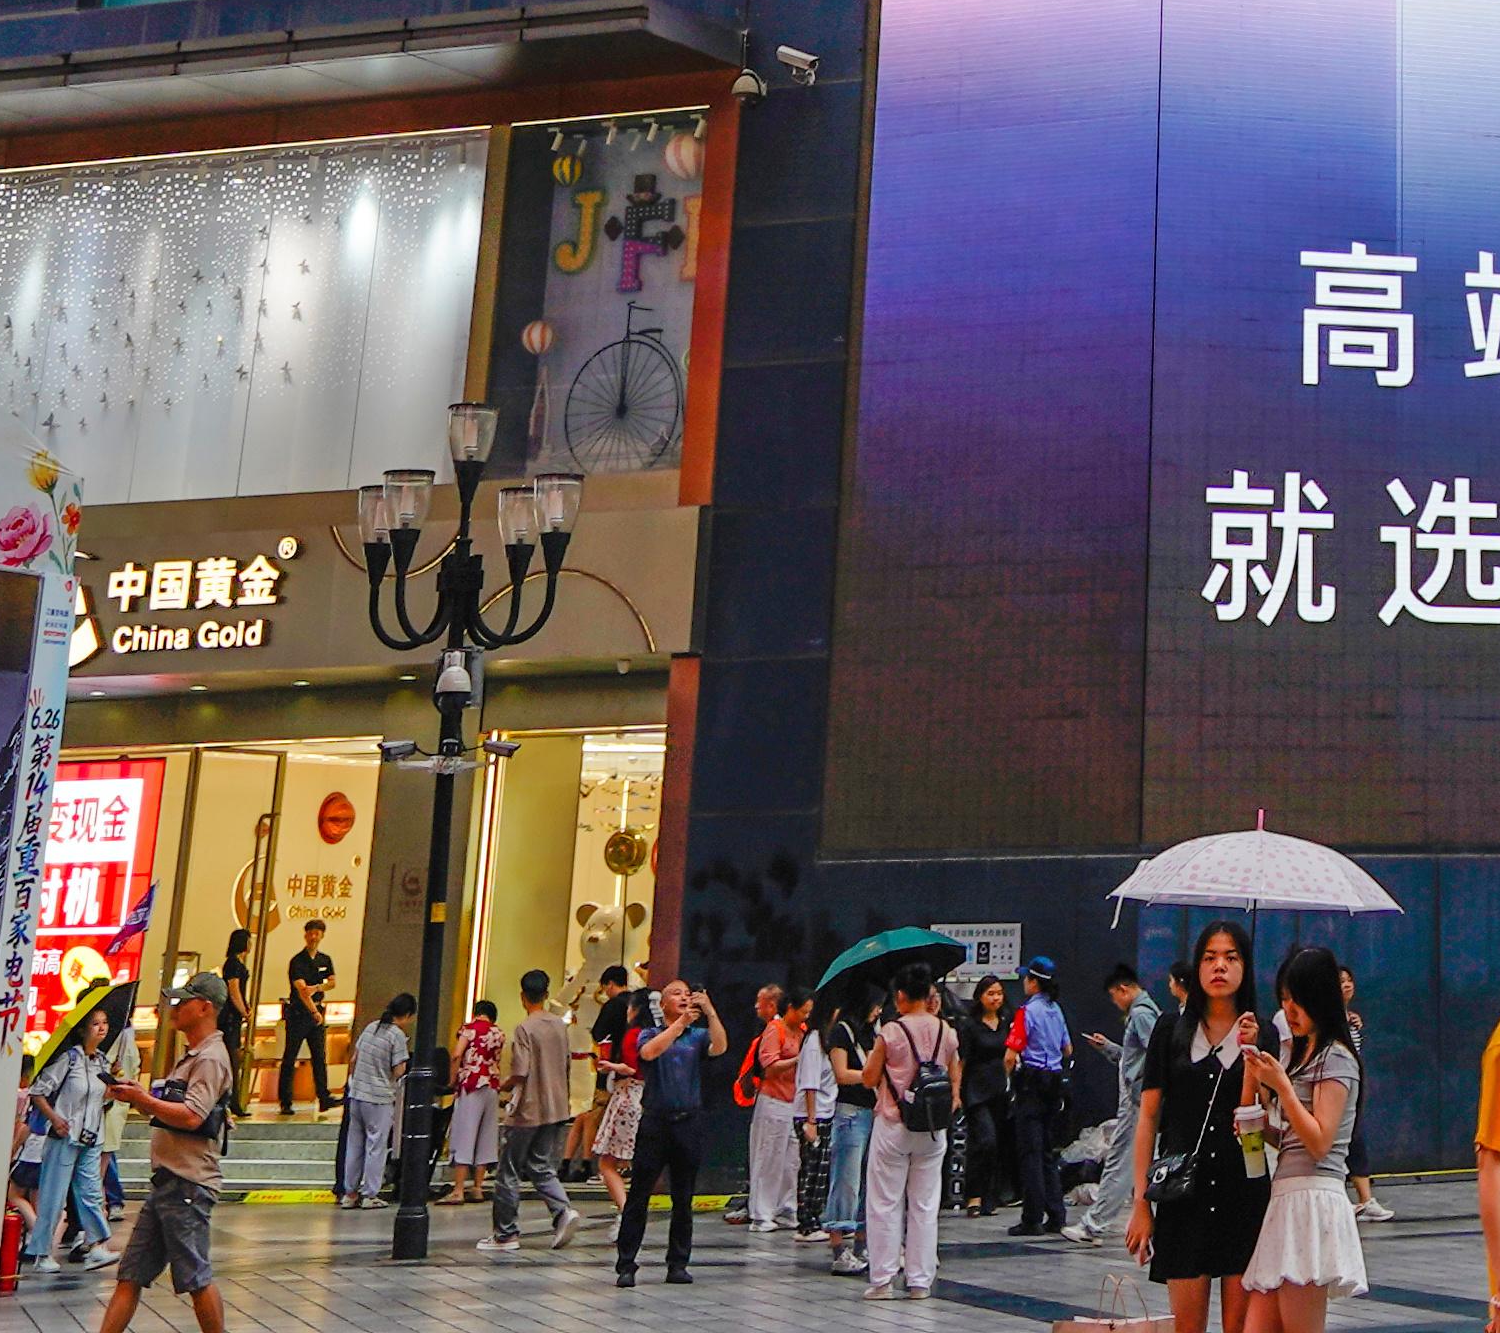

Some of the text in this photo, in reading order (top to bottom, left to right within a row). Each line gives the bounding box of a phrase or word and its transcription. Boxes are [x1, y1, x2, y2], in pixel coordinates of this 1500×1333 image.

[106, 554, 280, 613] 中国黄金
[112, 619, 265, 655] China Gold
[286, 874, 353, 900] 中国黄金
[321, 905, 347, 920] Gold
